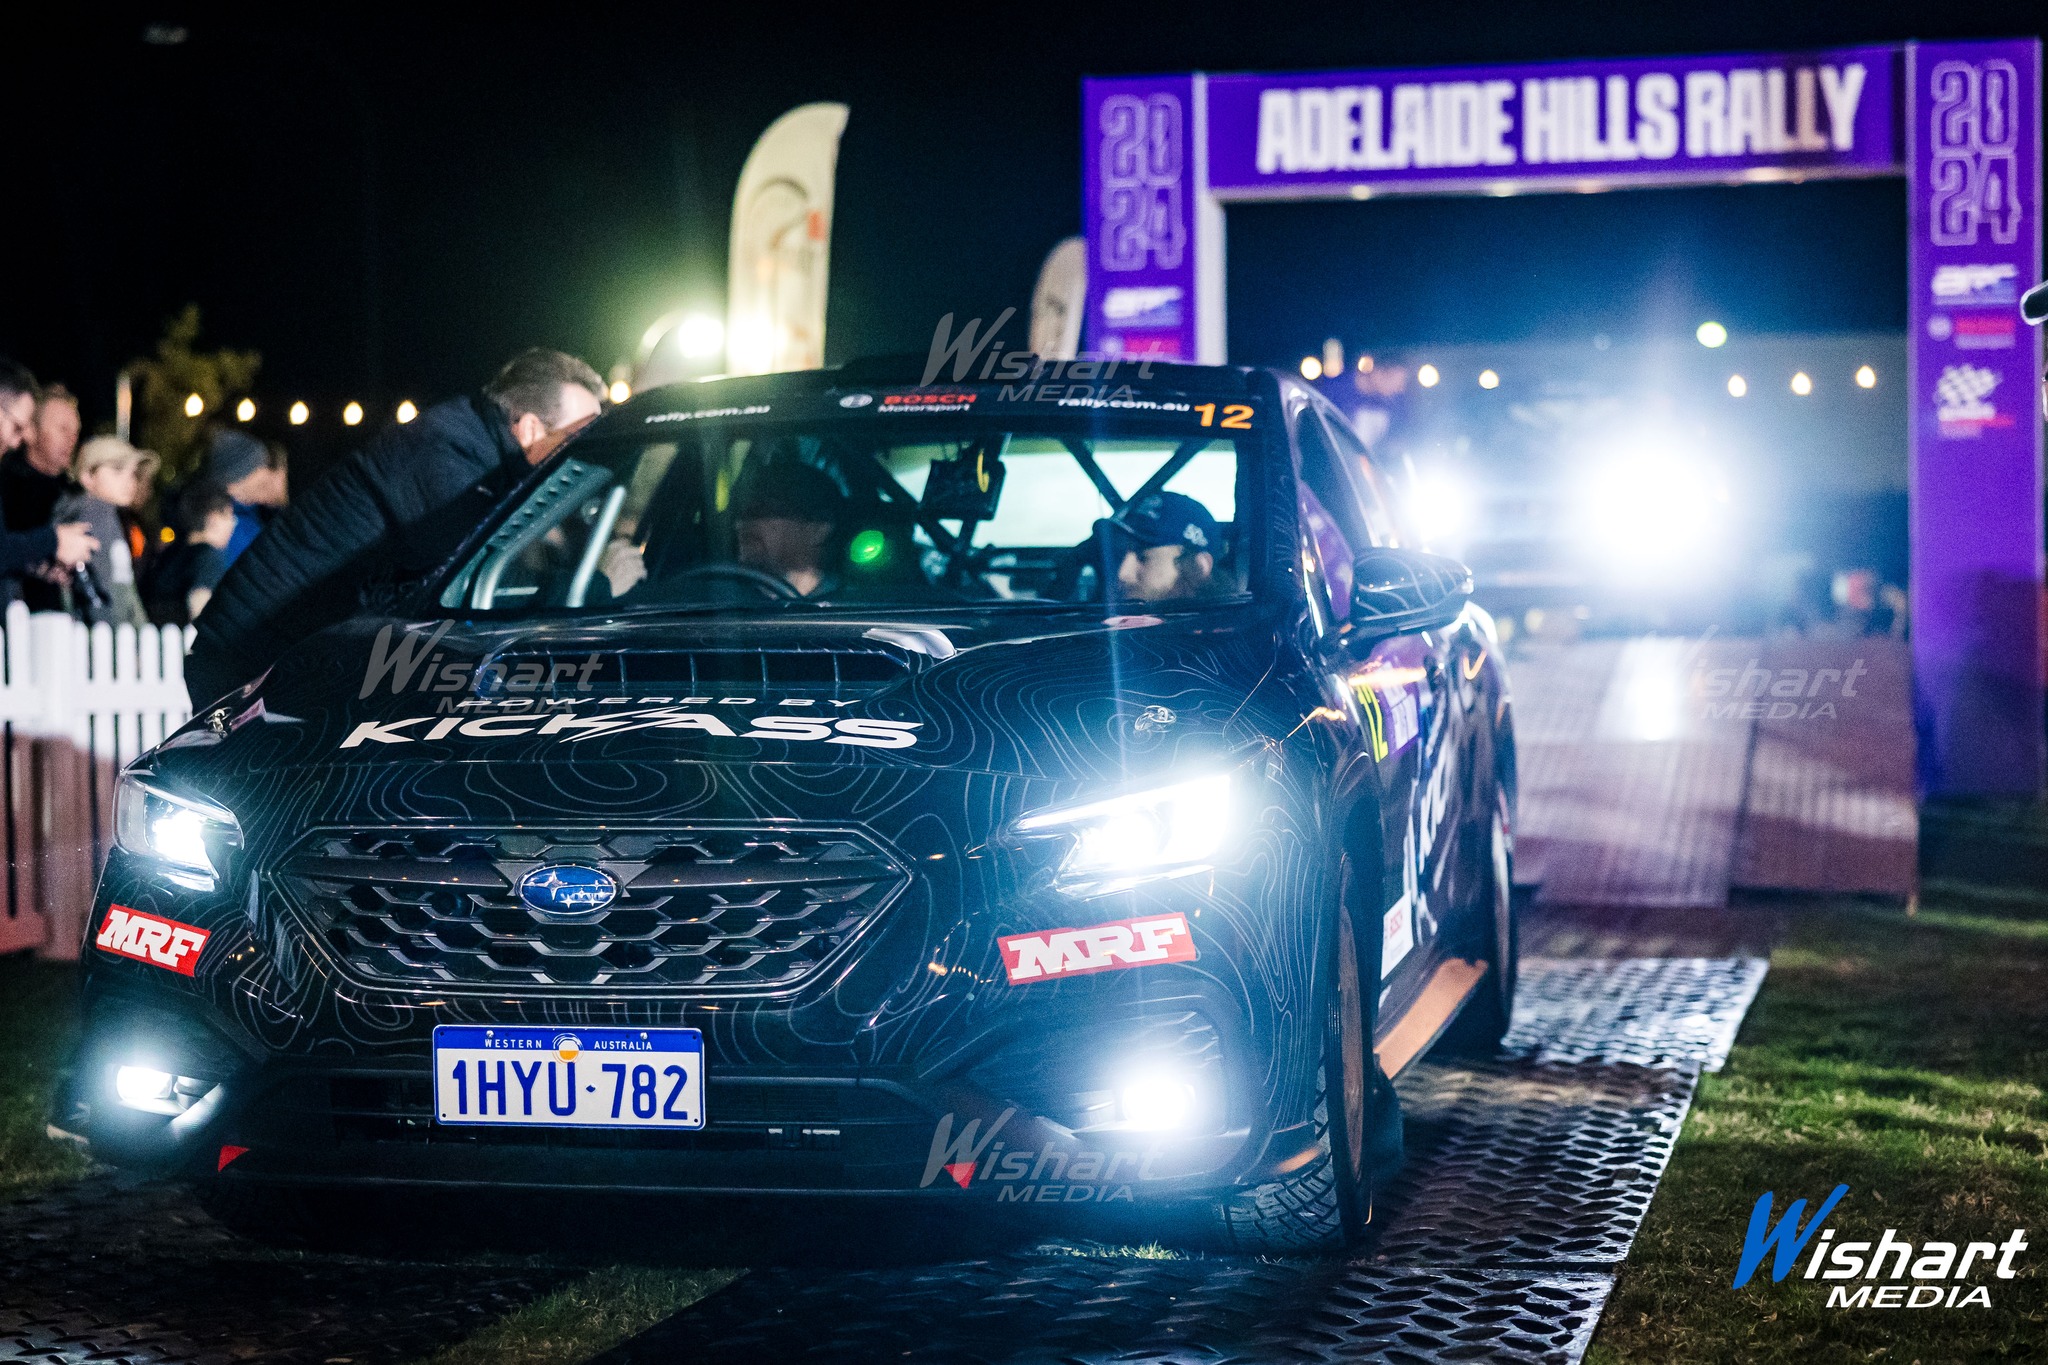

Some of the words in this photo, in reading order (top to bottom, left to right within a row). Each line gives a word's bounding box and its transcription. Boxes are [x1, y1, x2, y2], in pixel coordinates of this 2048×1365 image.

[1256, 80, 1516, 174] ADELAIDE
[1523, 72, 1680, 165] HILLS
[1685, 63, 1867, 158] RALLY
[884, 394, 976, 405] BOSCH
[1057, 397, 1190, 412] rally.com.au
[1194, 403, 1254, 429] 12
[456, 697, 756, 707] POWERED
[778, 698, 862, 707] BY
[339, 706, 925, 749] KICKASS
[97, 909, 207, 968] MRF
[1007, 918, 1187, 980] MRF
[484, 1039, 542, 1049] WESTERN
[594, 1040, 652, 1050] AUSTRALIA
